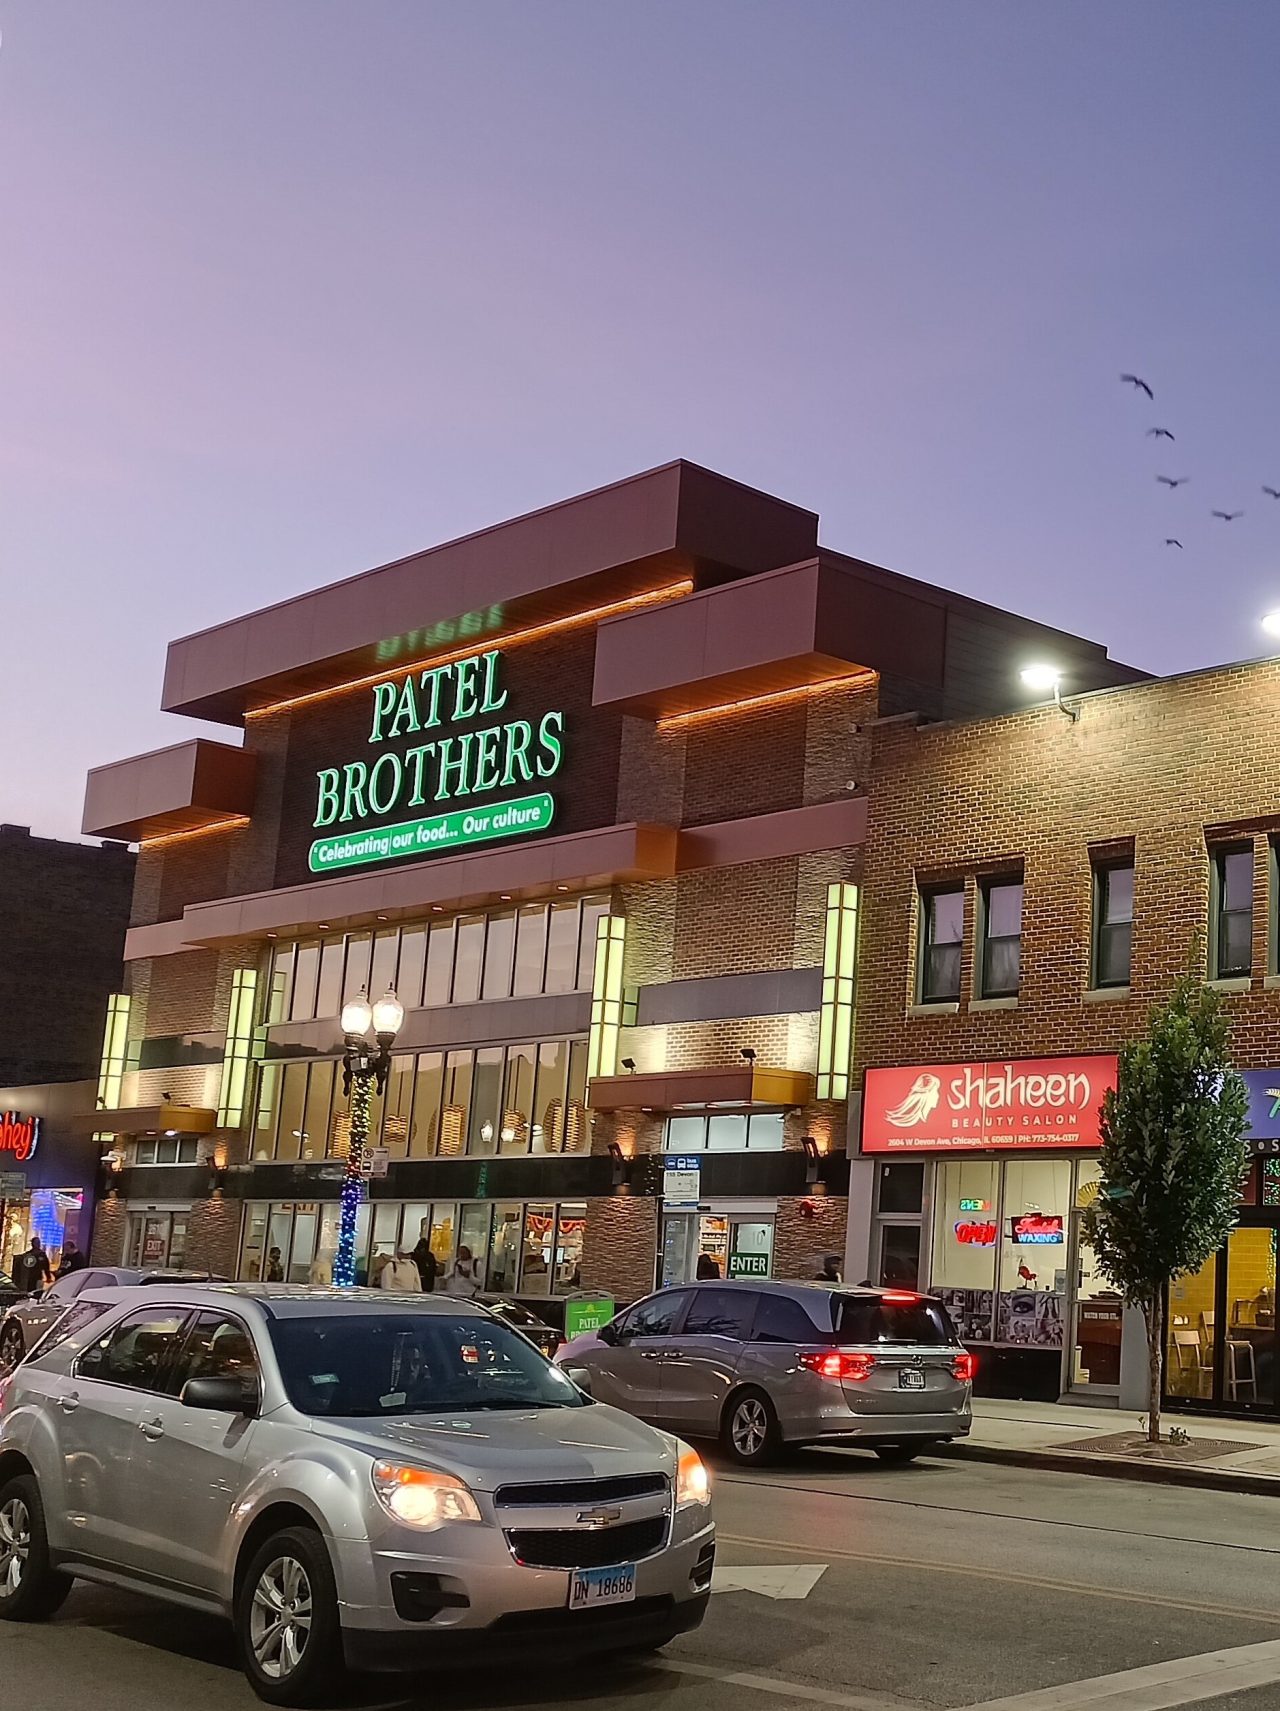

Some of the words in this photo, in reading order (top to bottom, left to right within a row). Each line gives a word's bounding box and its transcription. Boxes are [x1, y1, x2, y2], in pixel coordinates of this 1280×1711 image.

[369, 650, 508, 743] PATEL
[313, 711, 565, 828] BROTHERS
[393, 831, 415, 848] our
[462, 816, 489, 834] Our
[948, 1065, 1090, 1110] shaheen
[952, 1117, 1014, 1128] BEAUTY
[1022, 1114, 1077, 1126] SALON
[906, 1138, 914, 1146] W
[957, 1223, 997, 1243] OPEN
[1017, 1232, 1058, 1243] WAXING
[730, 1256, 766, 1272] ENTER
[579, 1317, 601, 1329] PATEL
[596, 1575, 633, 1598] 18686
